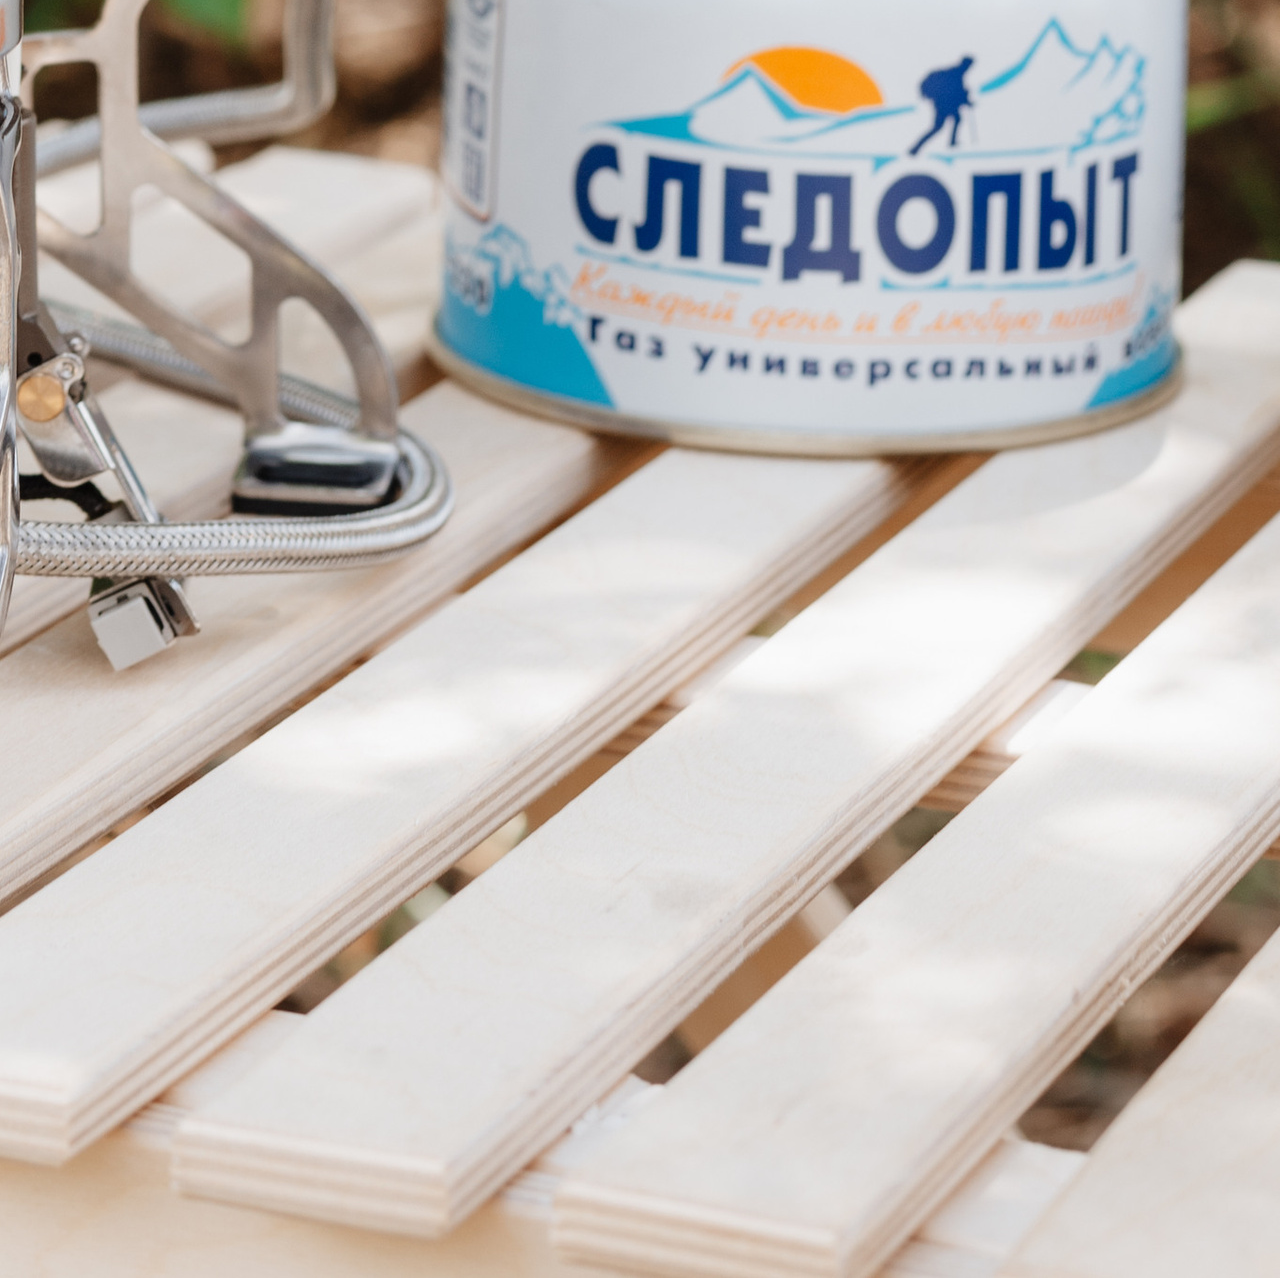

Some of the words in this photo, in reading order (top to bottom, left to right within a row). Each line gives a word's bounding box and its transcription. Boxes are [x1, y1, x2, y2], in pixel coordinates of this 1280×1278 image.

[573, 143, 1139, 284] СЛЕДОПЫТ
[588, 315, 665, 359] Газ
[694, 341, 1099, 387] универсальный
